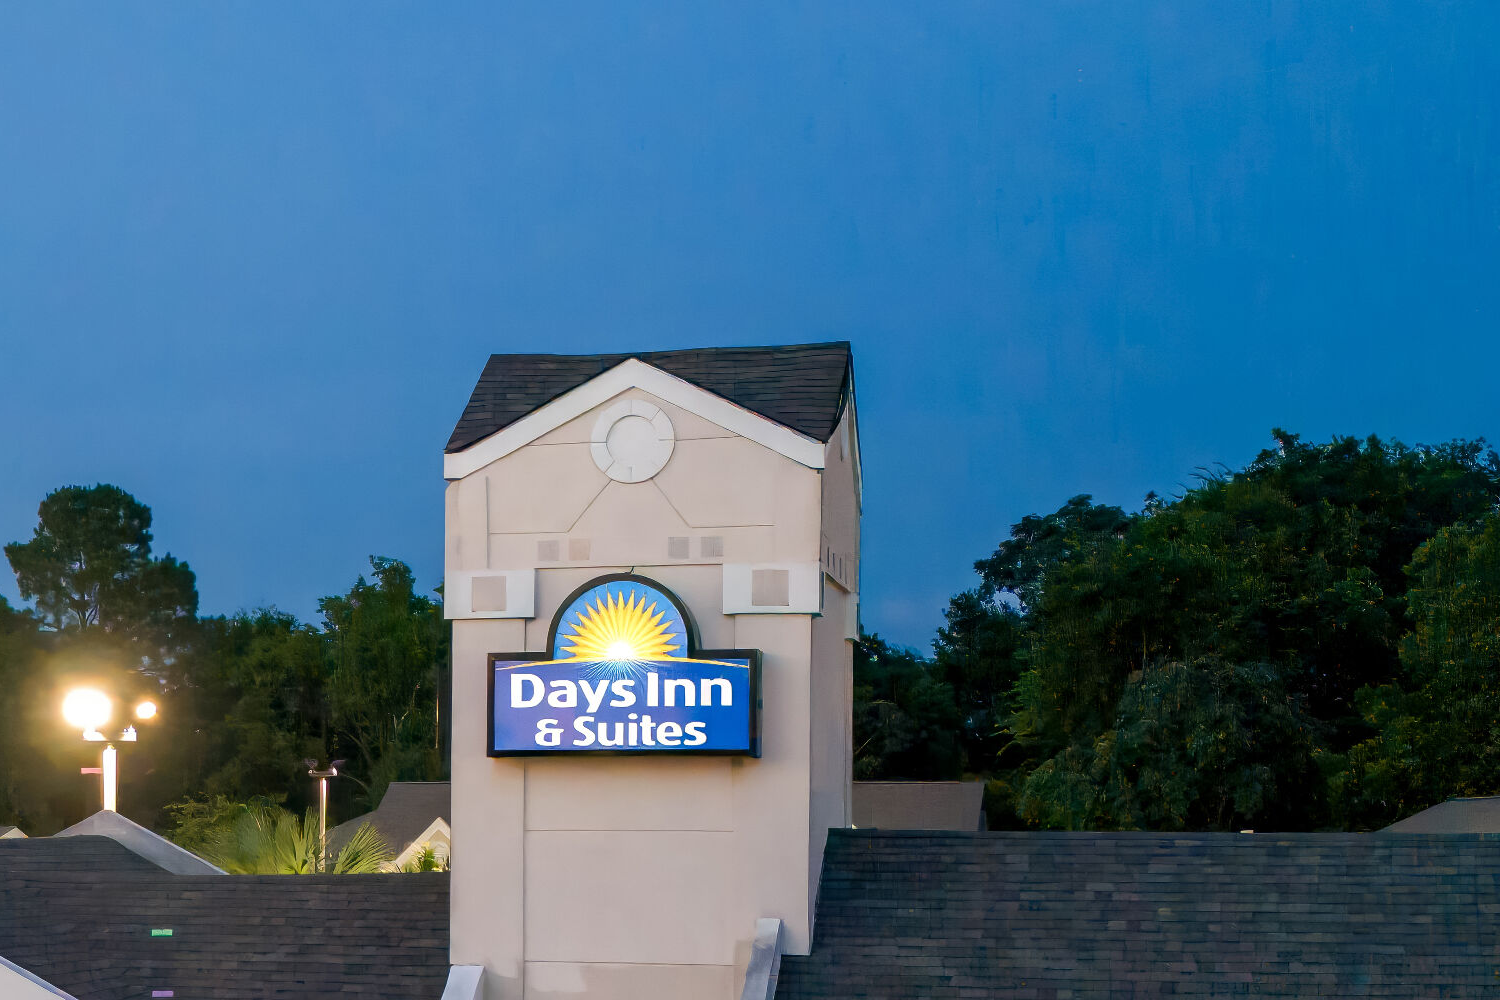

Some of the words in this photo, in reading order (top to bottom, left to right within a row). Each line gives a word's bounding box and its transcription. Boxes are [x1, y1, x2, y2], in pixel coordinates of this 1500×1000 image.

[510, 673, 637, 713] Days
[647, 671, 733, 707] Inn
[534, 718, 565, 747] &
[572, 713, 707, 747] Suites
